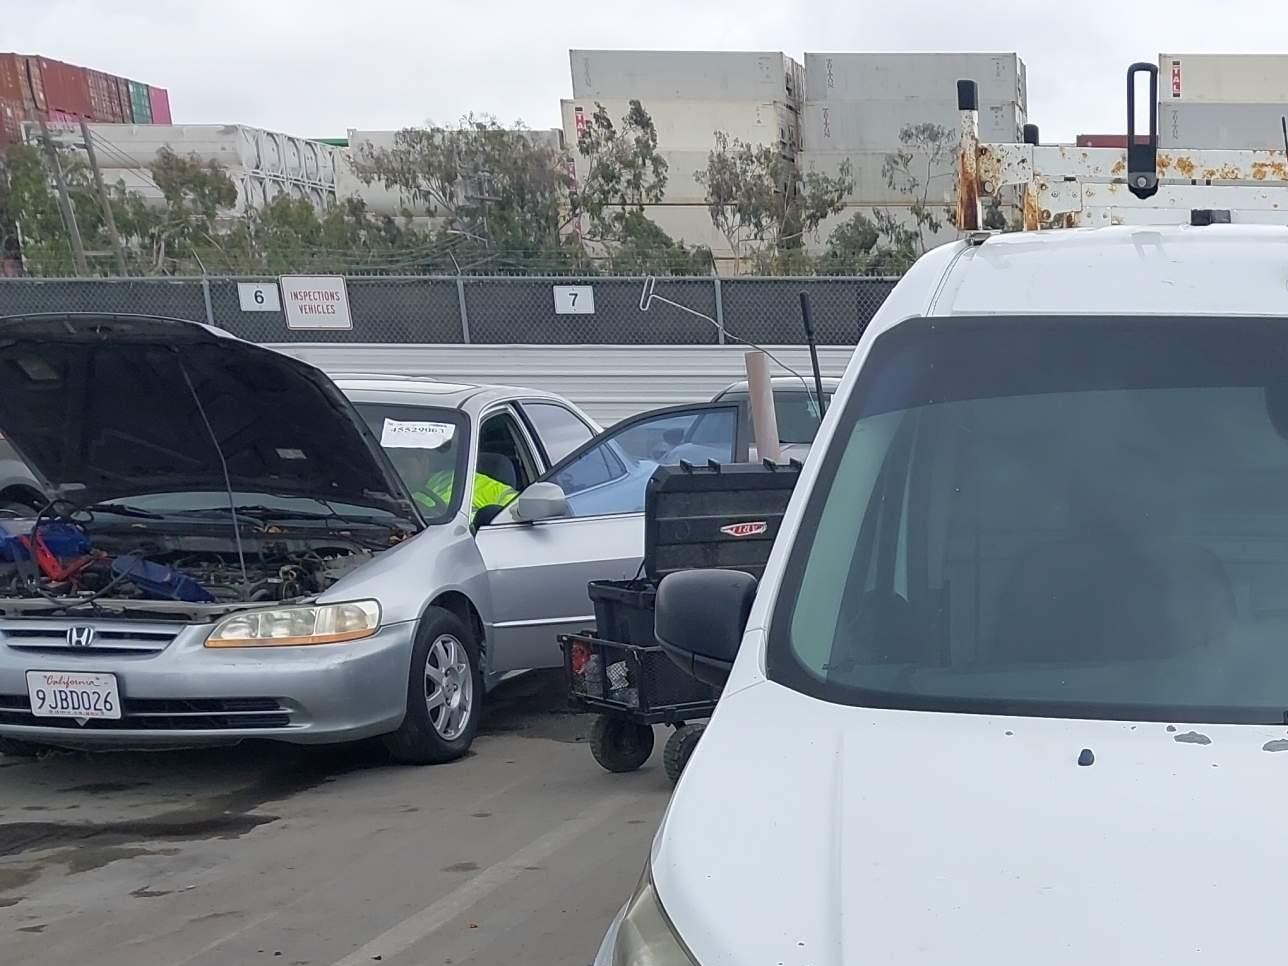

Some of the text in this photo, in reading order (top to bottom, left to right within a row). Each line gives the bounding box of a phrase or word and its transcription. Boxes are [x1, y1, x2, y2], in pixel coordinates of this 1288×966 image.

[254, 290, 265, 304] 6
[290, 290, 341, 302] INSPECTIONS
[568, 292, 578, 307] 7
[298, 304, 336, 315] VEHICLES
[46, 674, 96, 689] California
[36, 688, 113, 712] 9JBD026
